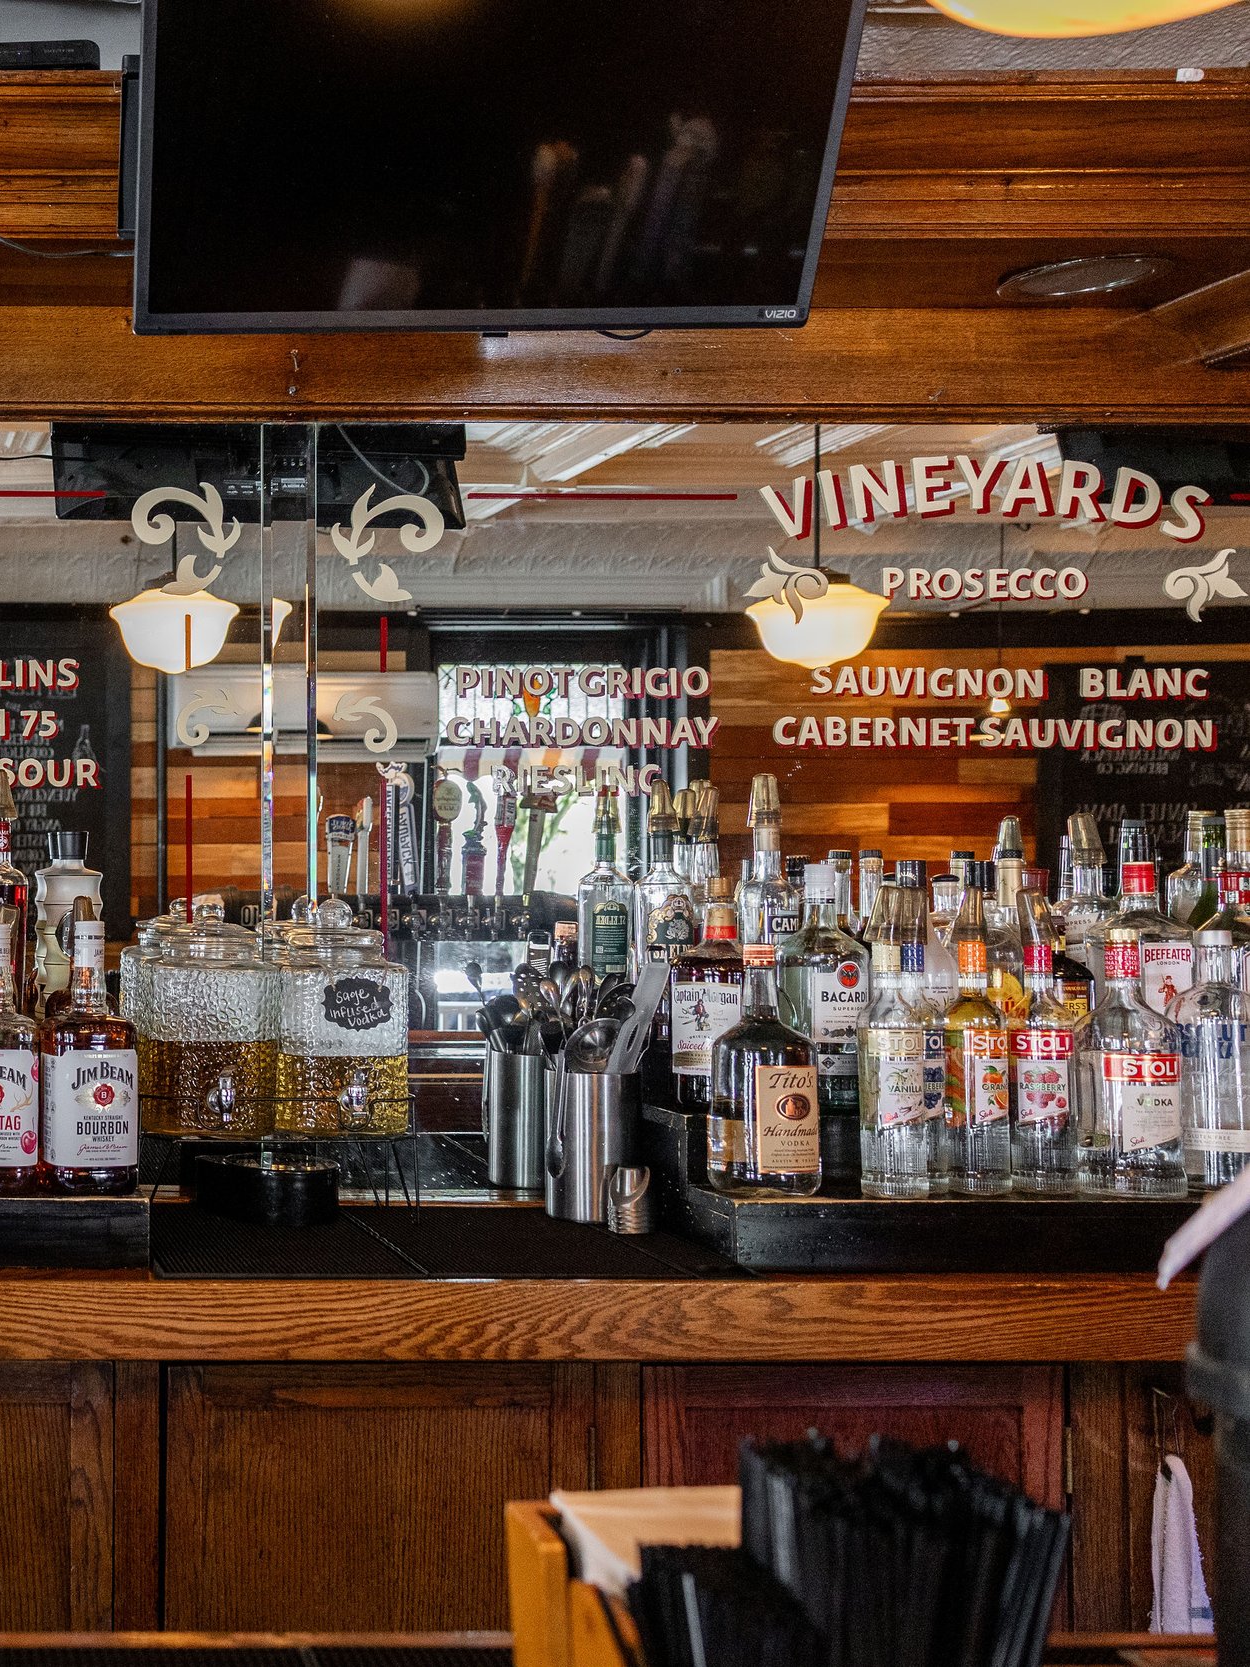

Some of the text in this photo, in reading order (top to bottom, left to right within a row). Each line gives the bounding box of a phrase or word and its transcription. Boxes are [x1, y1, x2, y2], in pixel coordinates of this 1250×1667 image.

[764, 309, 797, 319] VIZIO
[760, 455, 1212, 544] VINEYARDS
[883, 567, 1089, 601] PROSECCO
[456, 667, 712, 699] PINOT GRIGIO
[812, 667, 1210, 699] SAUVIGNON BLANC
[22, 710, 58, 740] 75
[448, 717, 720, 749] CHARDONNAY
[773, 717, 1217, 750] CABERNET SAUVIGNON
[1065, 918, 1092, 927] MPRESS
[1144, 948, 1192, 964] BEEFEATER
[674, 988, 699, 1004] Captain
[677, 1040, 705, 1051] Spiced
[877, 1036, 921, 1051] STOL
[974, 1036, 1007, 1052] STO
[1016, 1035, 1069, 1051] STOLI
[71, 1061, 134, 1090] JIM BEAM
[1122, 1059, 1177, 1076] STOLI
[769, 1071, 813, 1089] Tito's
[1020, 1083, 1066, 1092] RASBERRY
[888, 1084, 922, 1093] VANILLA
[77, 1121, 129, 1135] BOURBON
